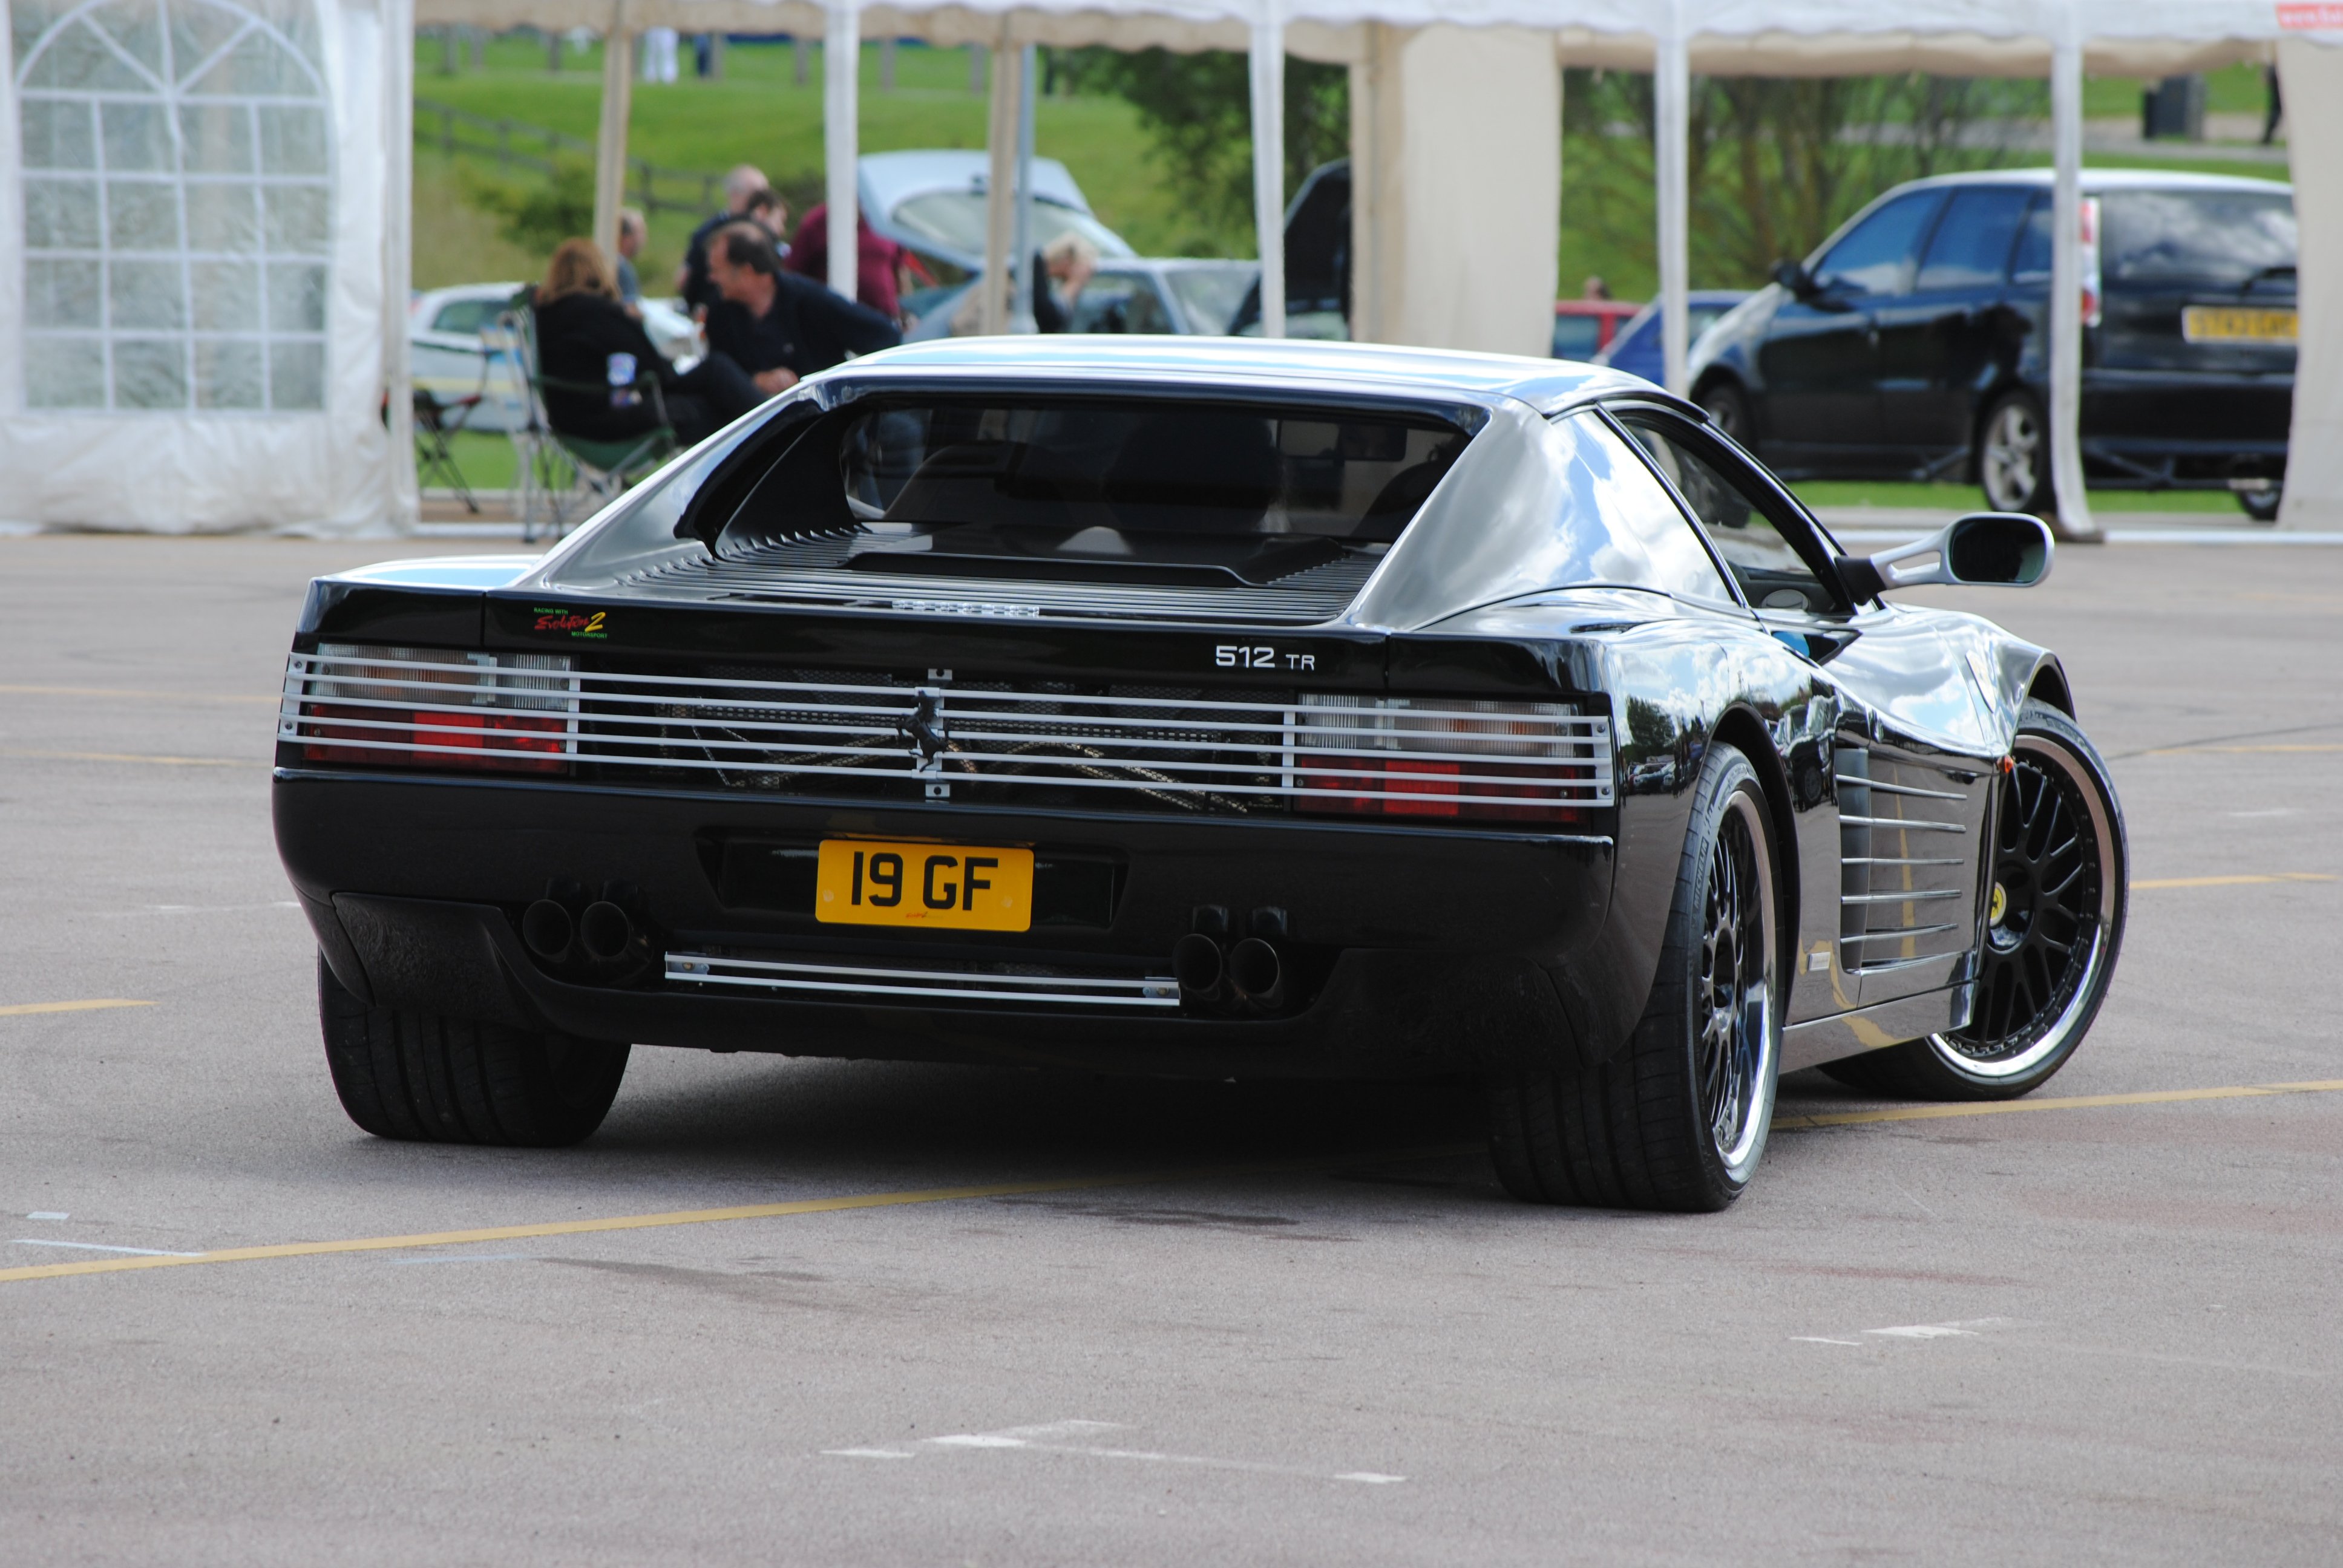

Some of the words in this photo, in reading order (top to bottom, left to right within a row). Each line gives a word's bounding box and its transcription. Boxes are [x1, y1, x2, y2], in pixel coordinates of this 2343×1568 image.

[585, 612, 606, 632] 2
[1216, 645, 1276, 668] 512
[1286, 655, 1314, 670] TR
[851, 851, 903, 907] 19
[923, 855, 998, 910] GF
[1694, 838, 1708, 909] MICHELIN
